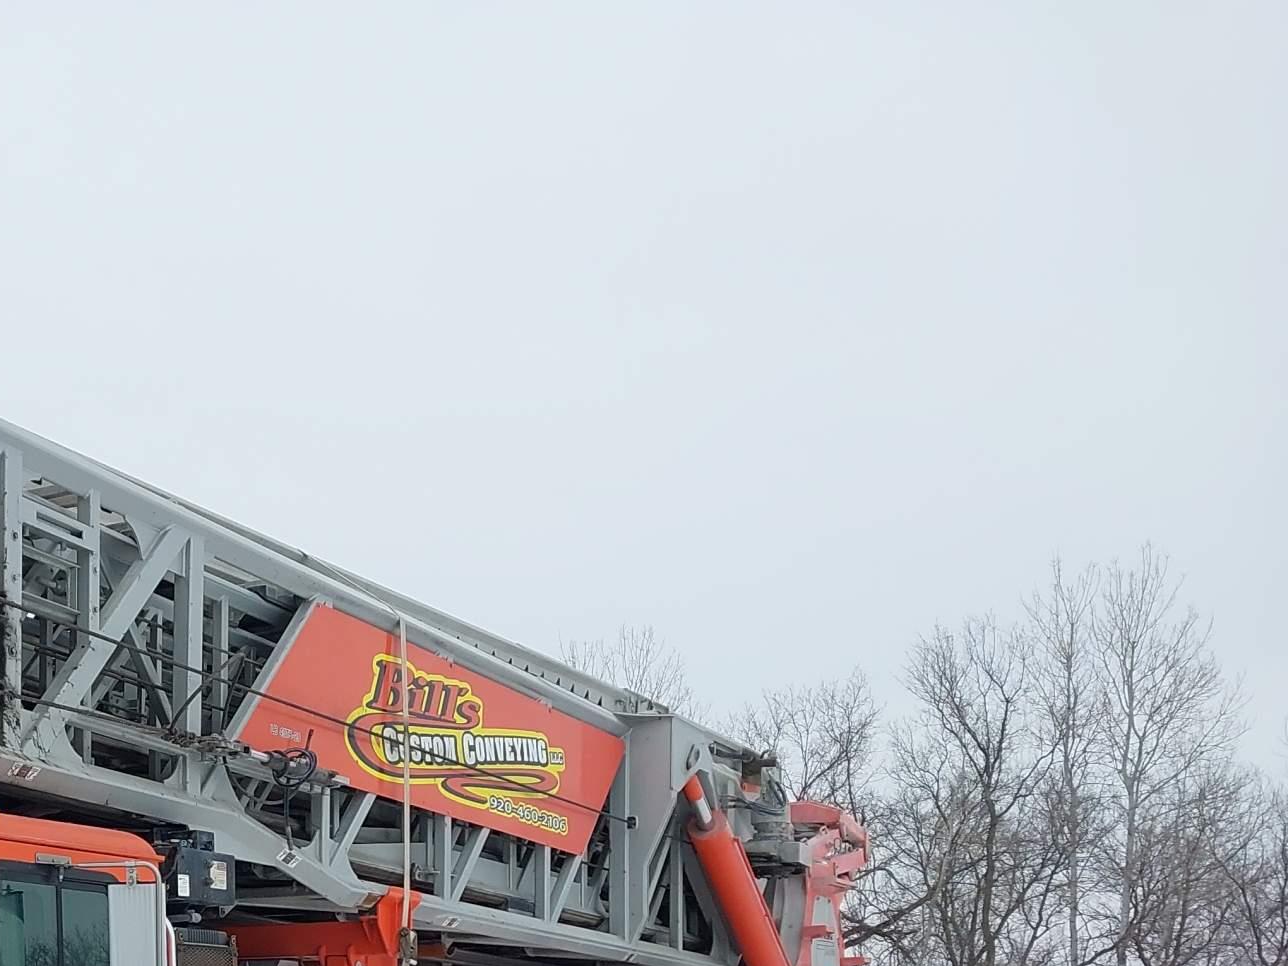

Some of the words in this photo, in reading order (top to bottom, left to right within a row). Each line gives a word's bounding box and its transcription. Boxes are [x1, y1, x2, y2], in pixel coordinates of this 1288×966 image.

[366, 659, 481, 729] Bill's
[462, 731, 548, 766] CONVEYING
[489, 796, 567, 833] 920-460-2106
